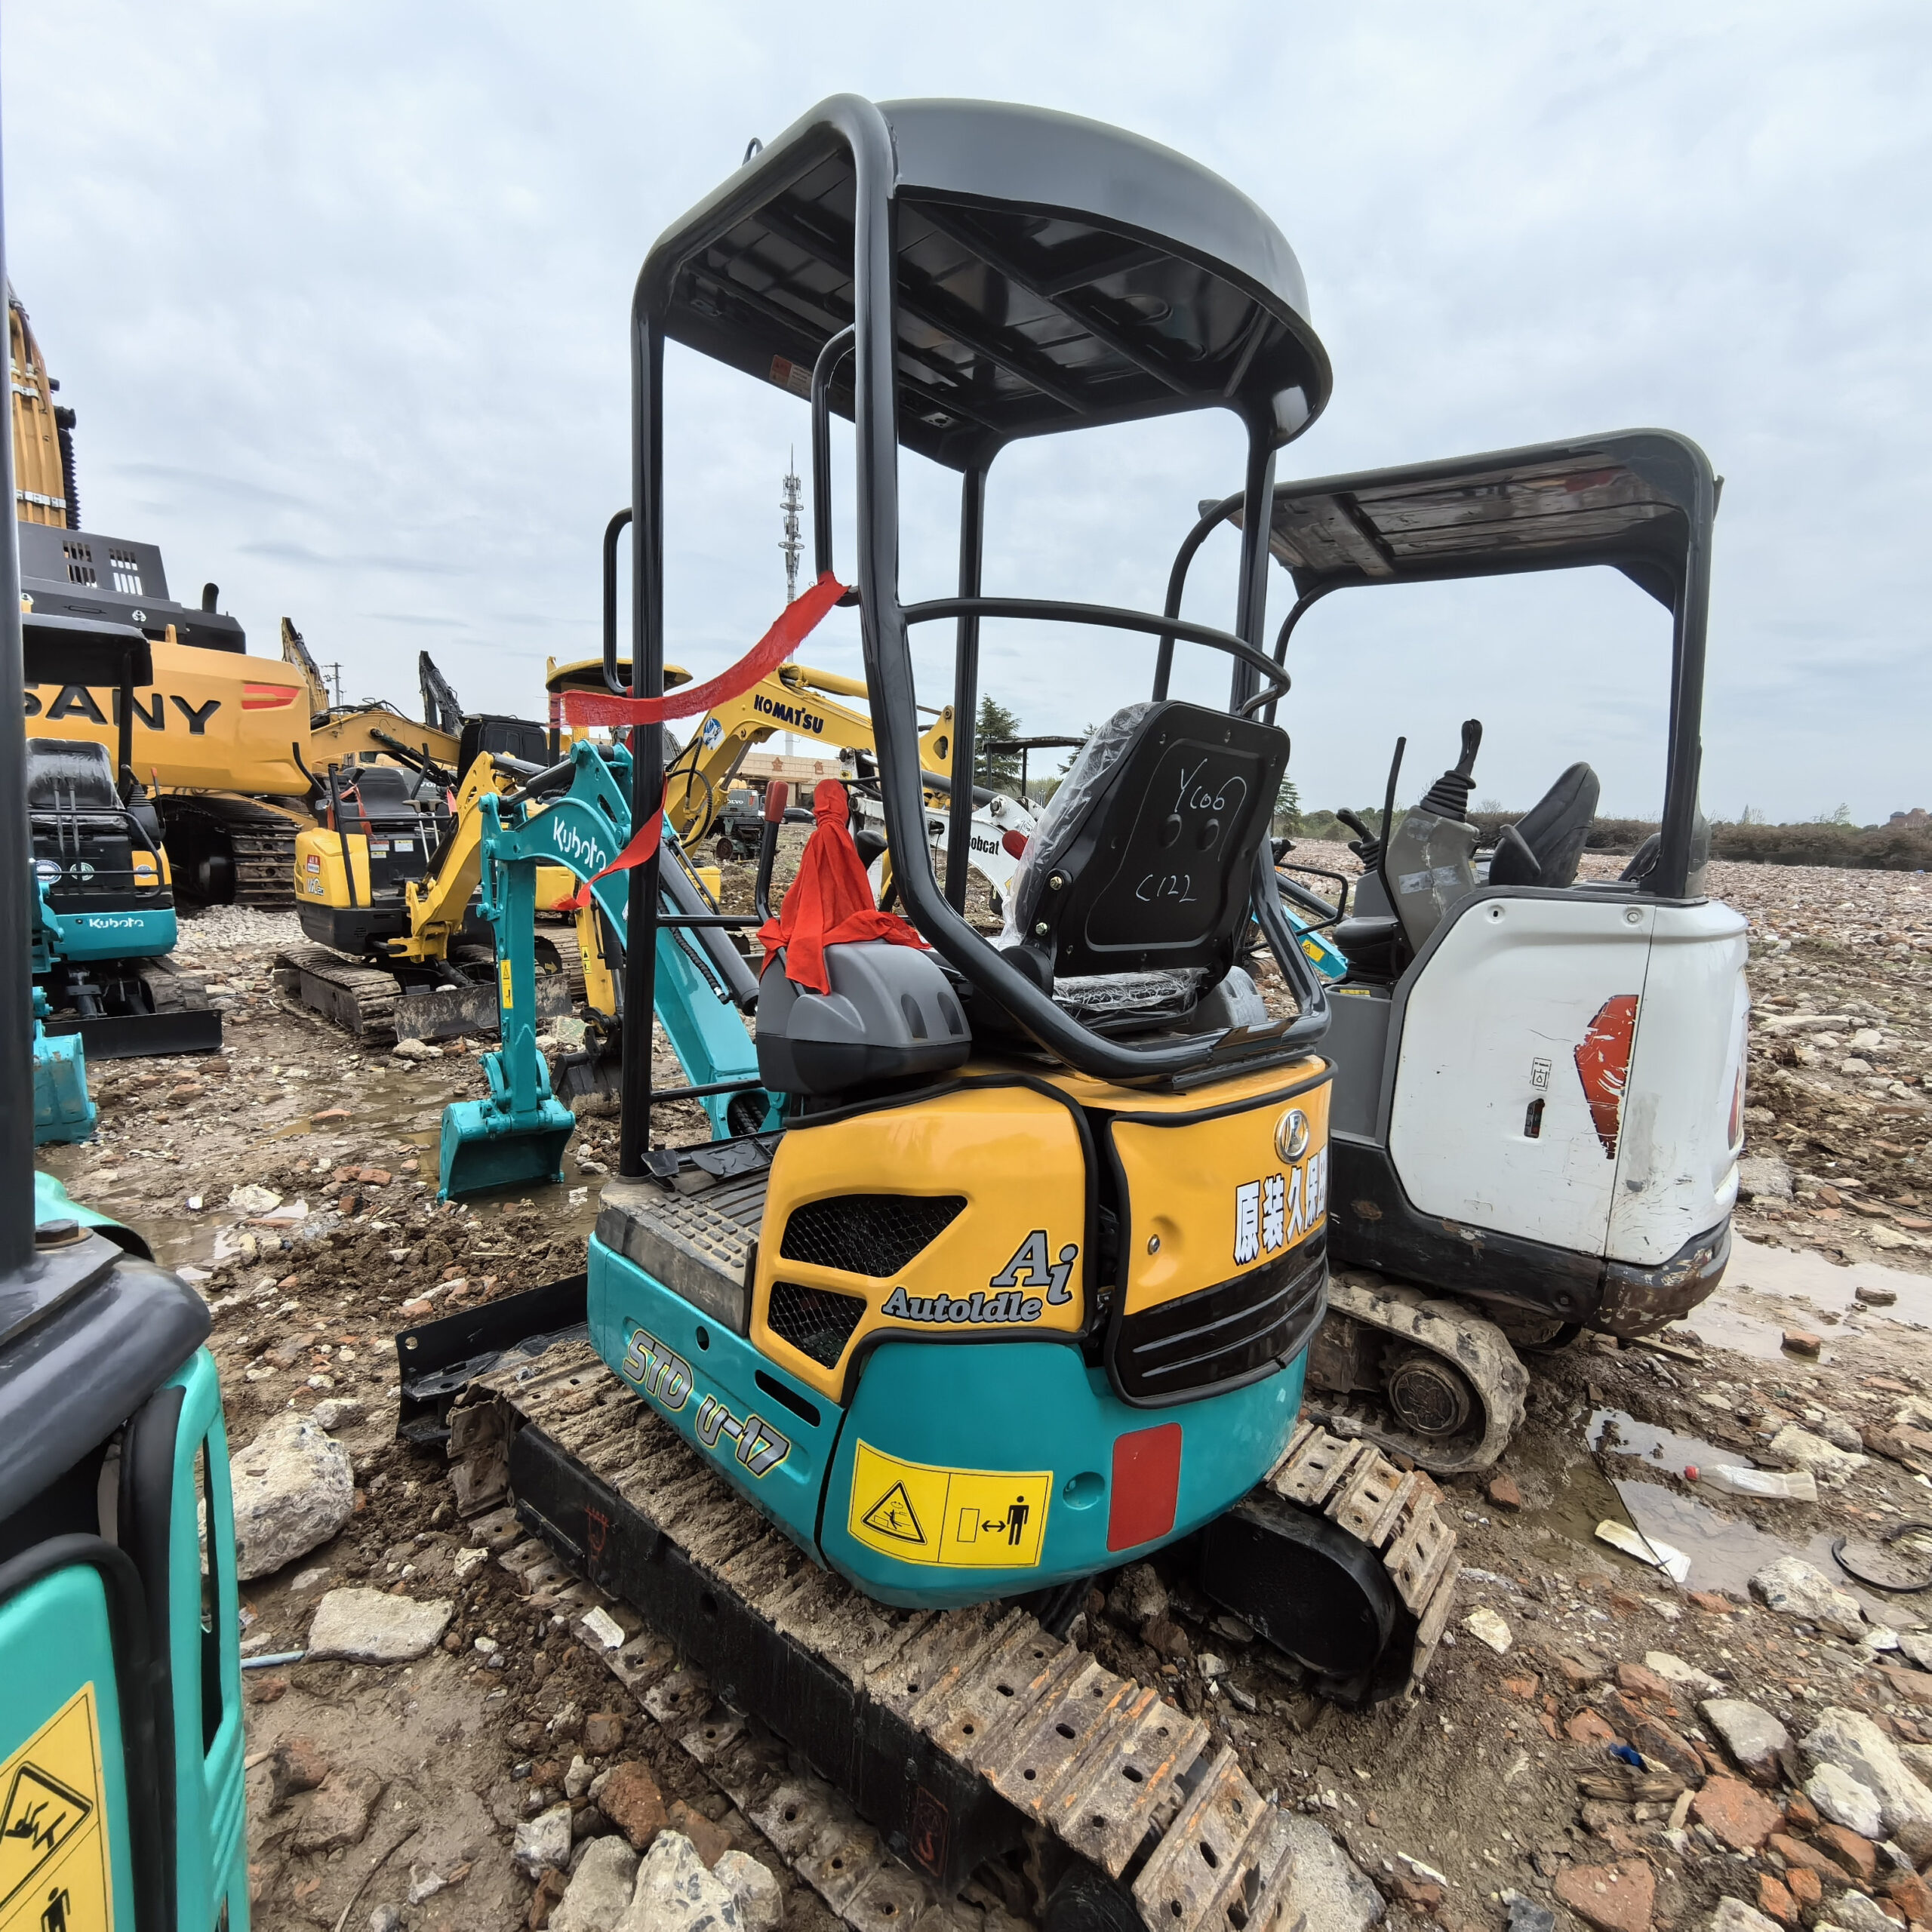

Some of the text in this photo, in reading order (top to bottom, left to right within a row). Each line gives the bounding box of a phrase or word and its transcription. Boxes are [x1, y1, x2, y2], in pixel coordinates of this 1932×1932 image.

[753, 694, 824, 734] KOMATSU
[553, 816, 607, 872] Kubota
[969, 835, 1000, 856] obcat
[1136, 874, 1198, 903] C122
[89, 917, 145, 929] Kubota
[989, 1229, 1079, 1306] Ai
[623, 1330, 790, 1477] STD U-17
